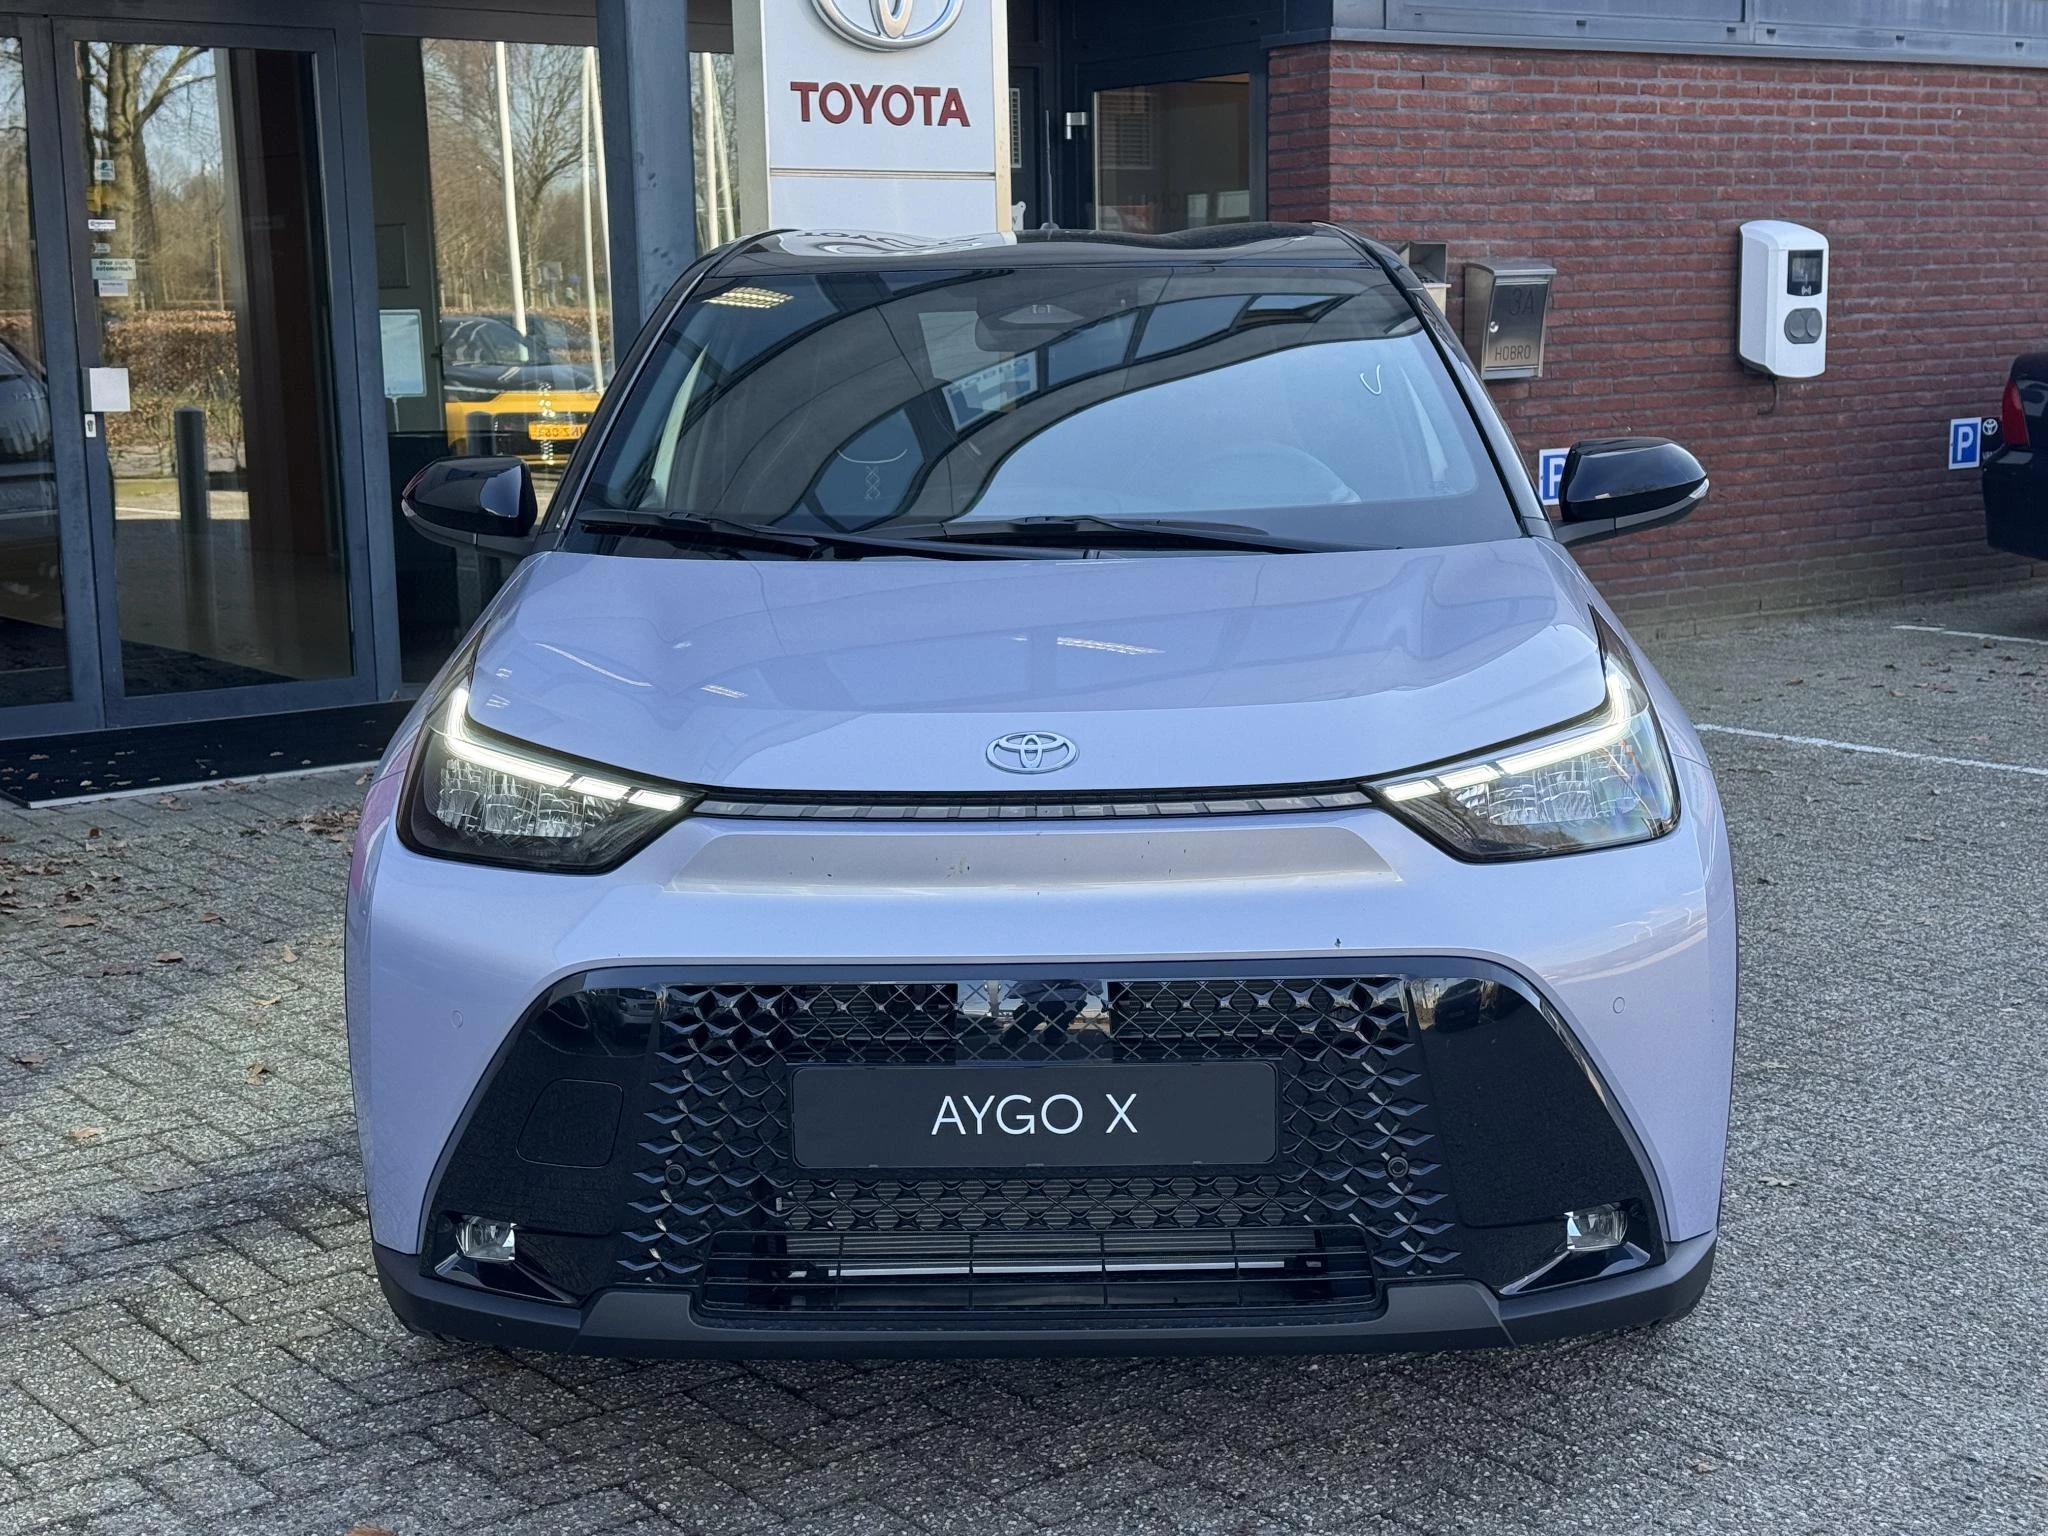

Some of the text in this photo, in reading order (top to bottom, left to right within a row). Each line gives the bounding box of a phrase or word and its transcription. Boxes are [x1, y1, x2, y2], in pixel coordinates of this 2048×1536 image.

[790, 81, 971, 127] TOYOTA
[1510, 288, 1535, 316] 3A
[1494, 344, 1532, 361] HOBRO
[1957, 426, 1974, 460] P
[1549, 457, 1566, 497] P
[931, 1093, 1138, 1136] AYGO X
